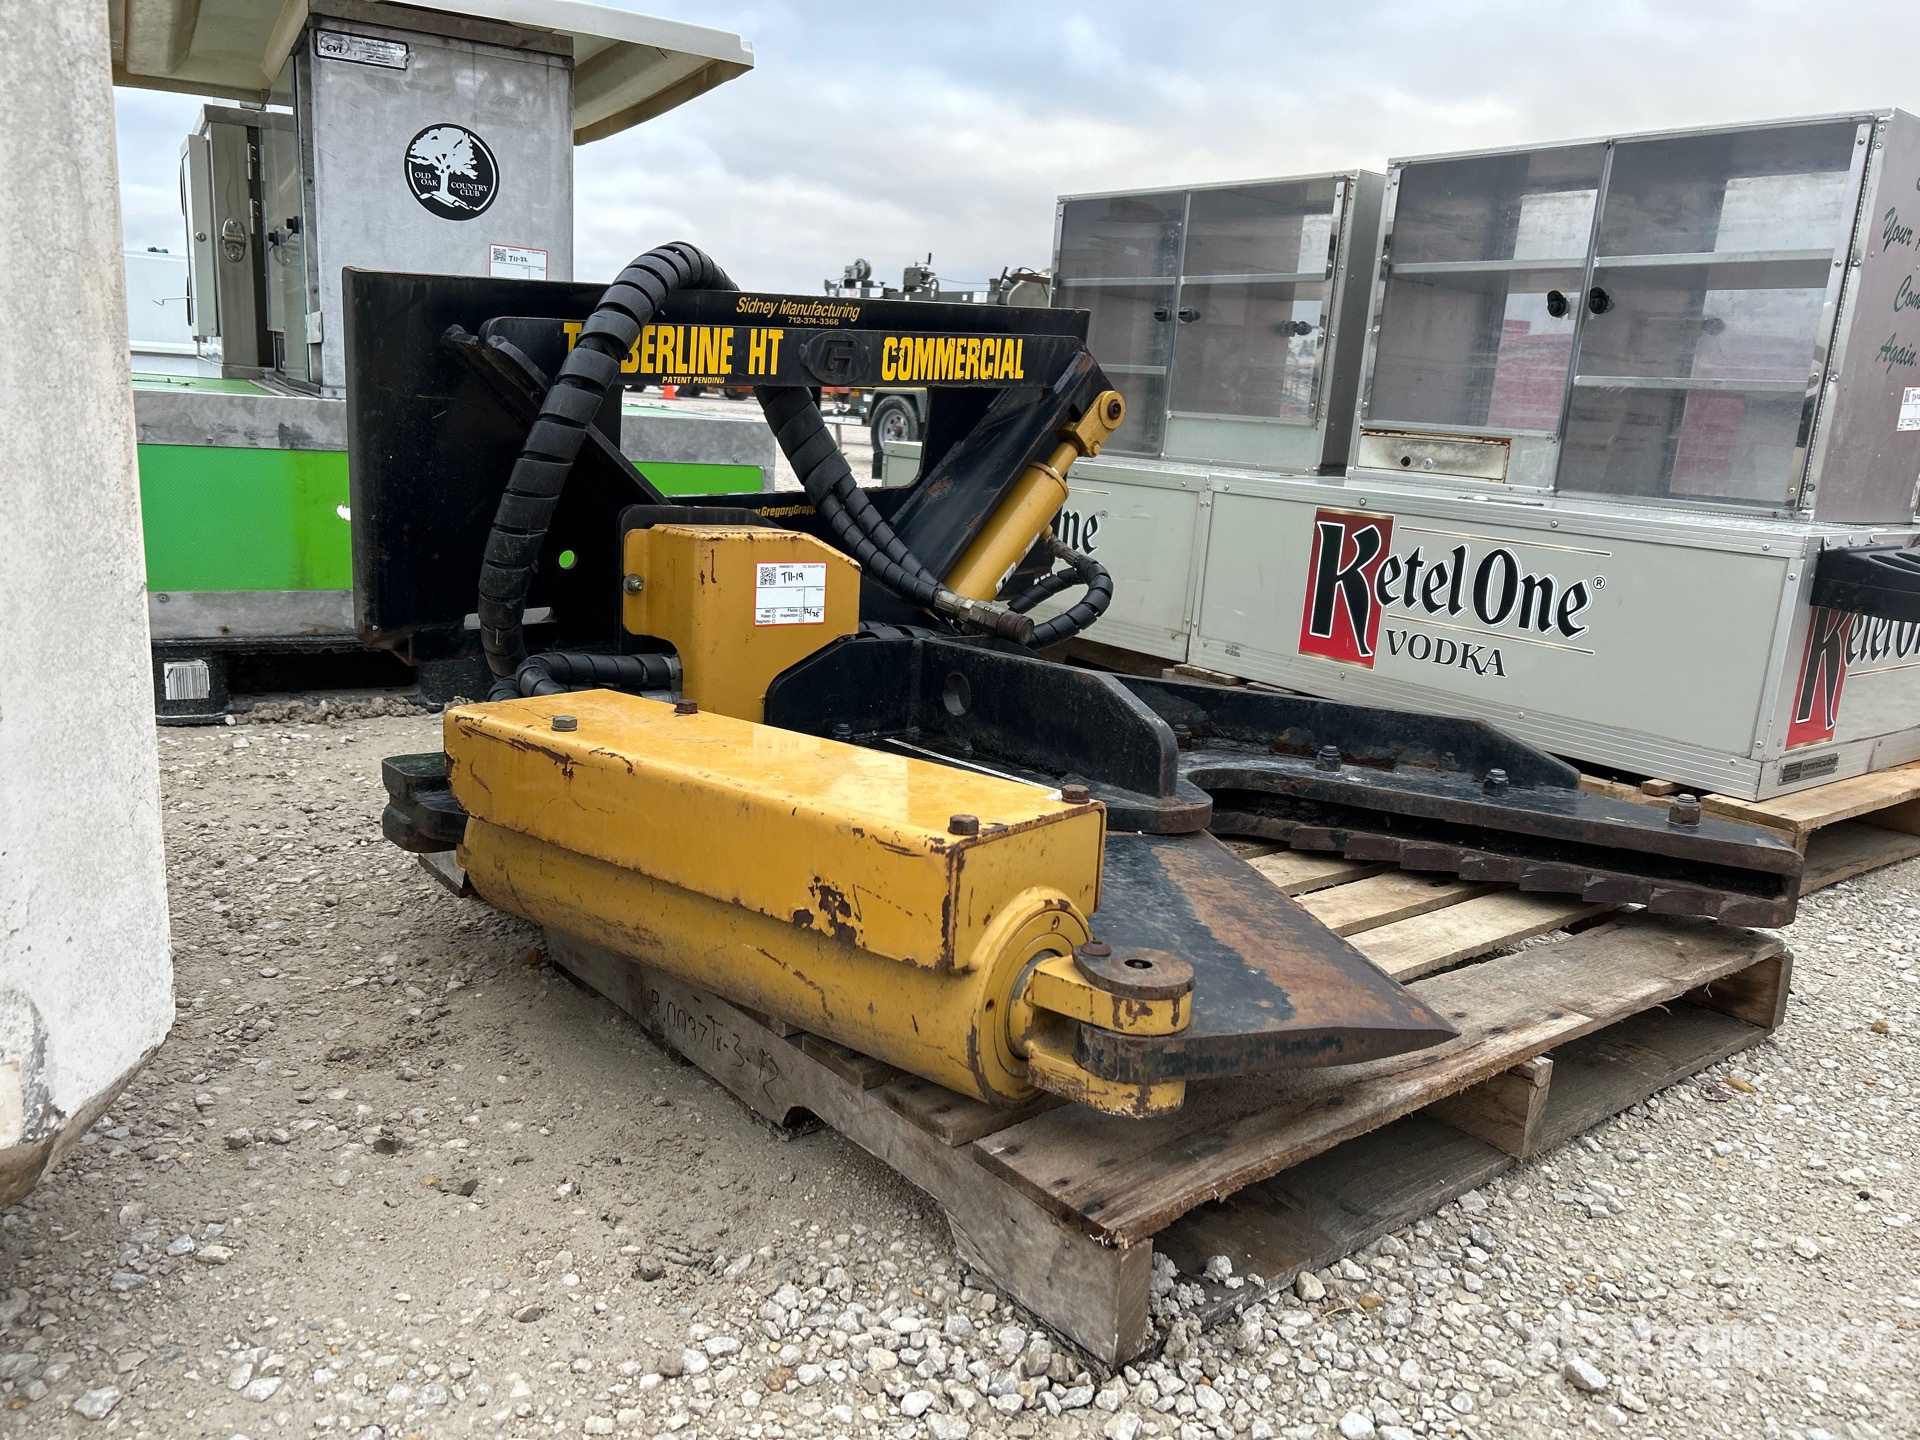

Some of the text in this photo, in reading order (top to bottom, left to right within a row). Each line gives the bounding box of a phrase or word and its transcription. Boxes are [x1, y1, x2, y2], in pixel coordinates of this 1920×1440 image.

[414, 171, 431, 180] OLD
[420, 178, 438, 187] OAK
[450, 181, 489, 192] COUNTRY
[460, 188, 481, 197] CLUB
[1882, 206, 1913, 253] Your
[736, 296, 861, 322] Sidney Manufacturing
[788, 316, 840, 326] 712-374-3366
[563, 322, 784, 375] TBERLINE HT
[881, 336, 1024, 381] COMMERCIAL
[662, 376, 725, 385] PATENT PENDING
[1309, 521, 1468, 657] Ketel
[1385, 627, 1507, 678] VODKA
[1802, 756, 1838, 772] omnicube
